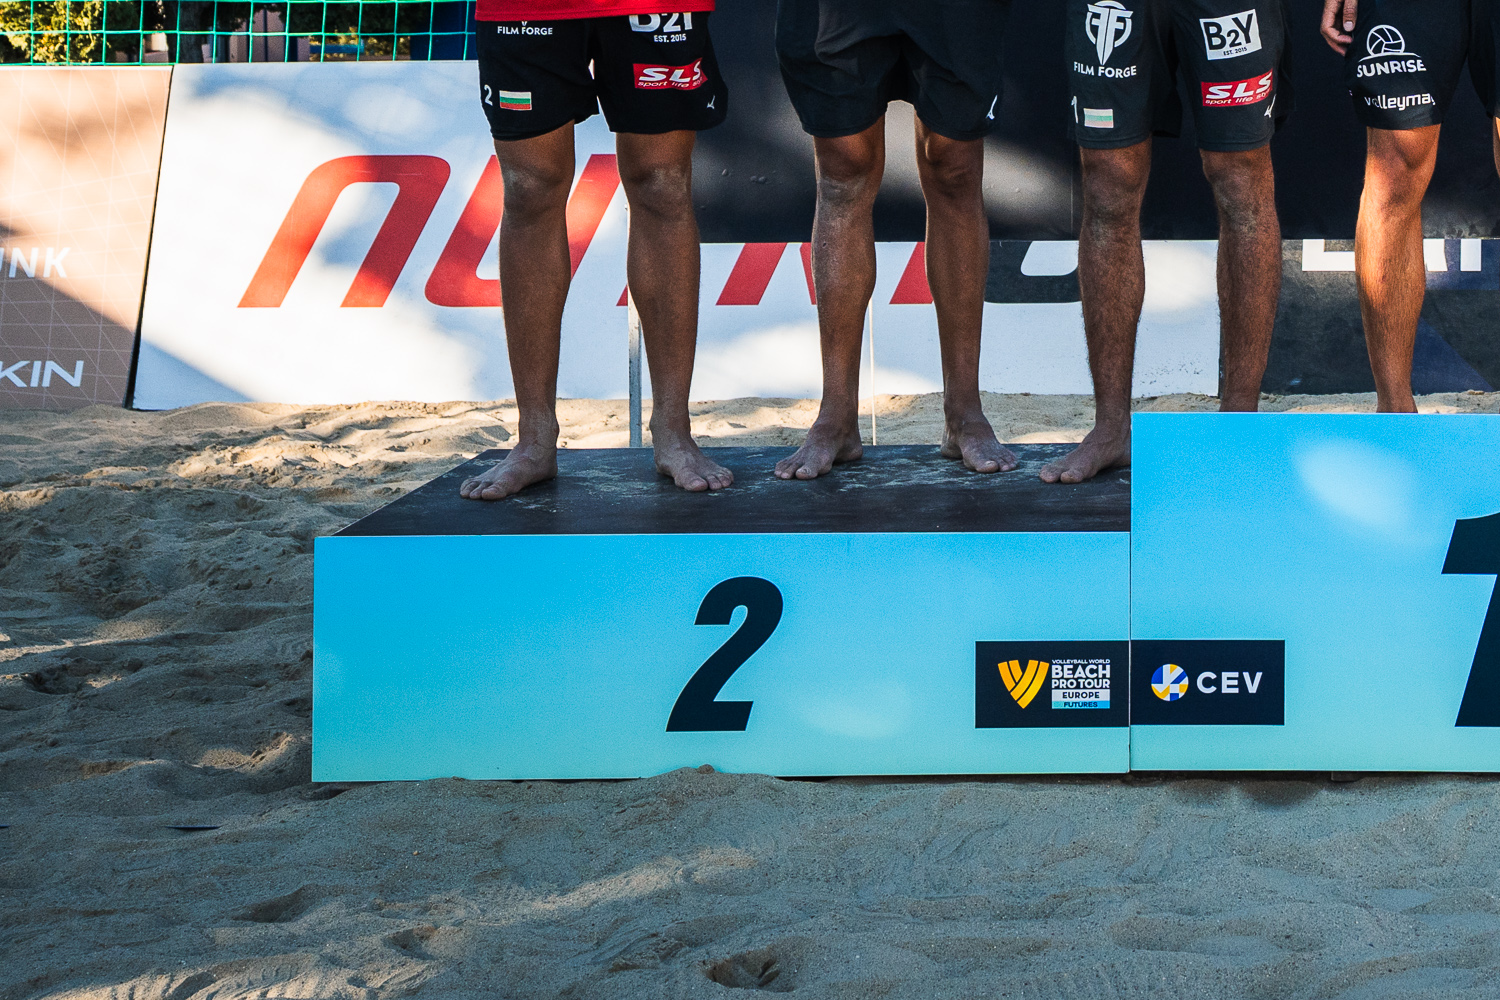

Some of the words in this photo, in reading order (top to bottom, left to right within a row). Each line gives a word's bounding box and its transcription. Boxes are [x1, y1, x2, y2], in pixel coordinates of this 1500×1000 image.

[497, 26, 520, 35] FILM
[521, 26, 553, 36] FORGE
[653, 34, 670, 43] EST.
[670, 33, 687, 42] 2015
[1203, 13, 1254, 50] B2Y
[638, 61, 701, 83] SLS
[1074, 61, 1095, 76] FILM
[1097, 65, 1137, 78] FORGE
[1356, 59, 1427, 78] SUNRISE
[484, 84, 493, 105] 2
[1205, 71, 1273, 100] SLS
[666, 576, 783, 733] 2
[1051, 665, 1111, 678] BEACH
[1051, 678, 1077, 689] PRO
[1078, 678, 1111, 689] TOUR
[1196, 671, 1263, 694] CEV
[1062, 691, 1100, 699] EUROPE
